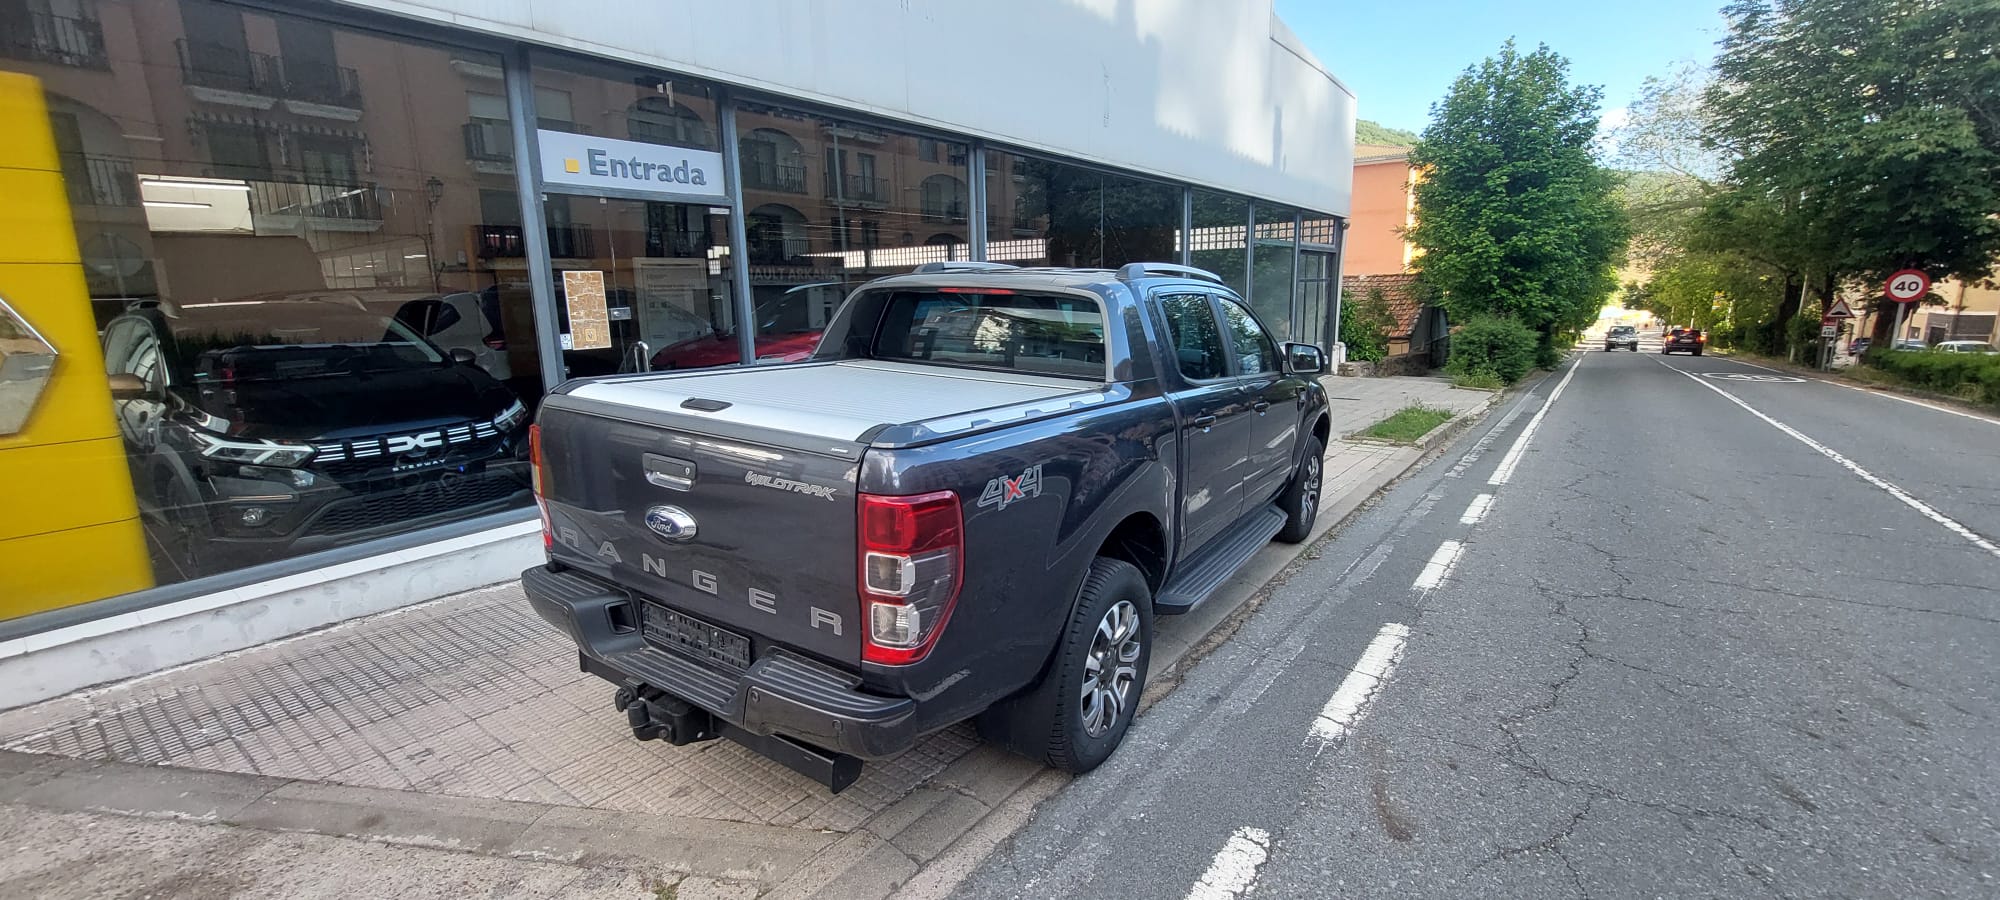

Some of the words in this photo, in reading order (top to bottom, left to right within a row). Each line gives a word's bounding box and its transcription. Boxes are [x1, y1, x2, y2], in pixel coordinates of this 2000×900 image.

[587, 148, 706, 186] Entrada
[1894, 281, 1920, 291] 40
[392, 459, 446, 472] STEPWAY
[744, 470, 838, 502] WILDTRAK
[650, 515, 673, 533] Ford
[559, 526, 844, 637] RANGER
